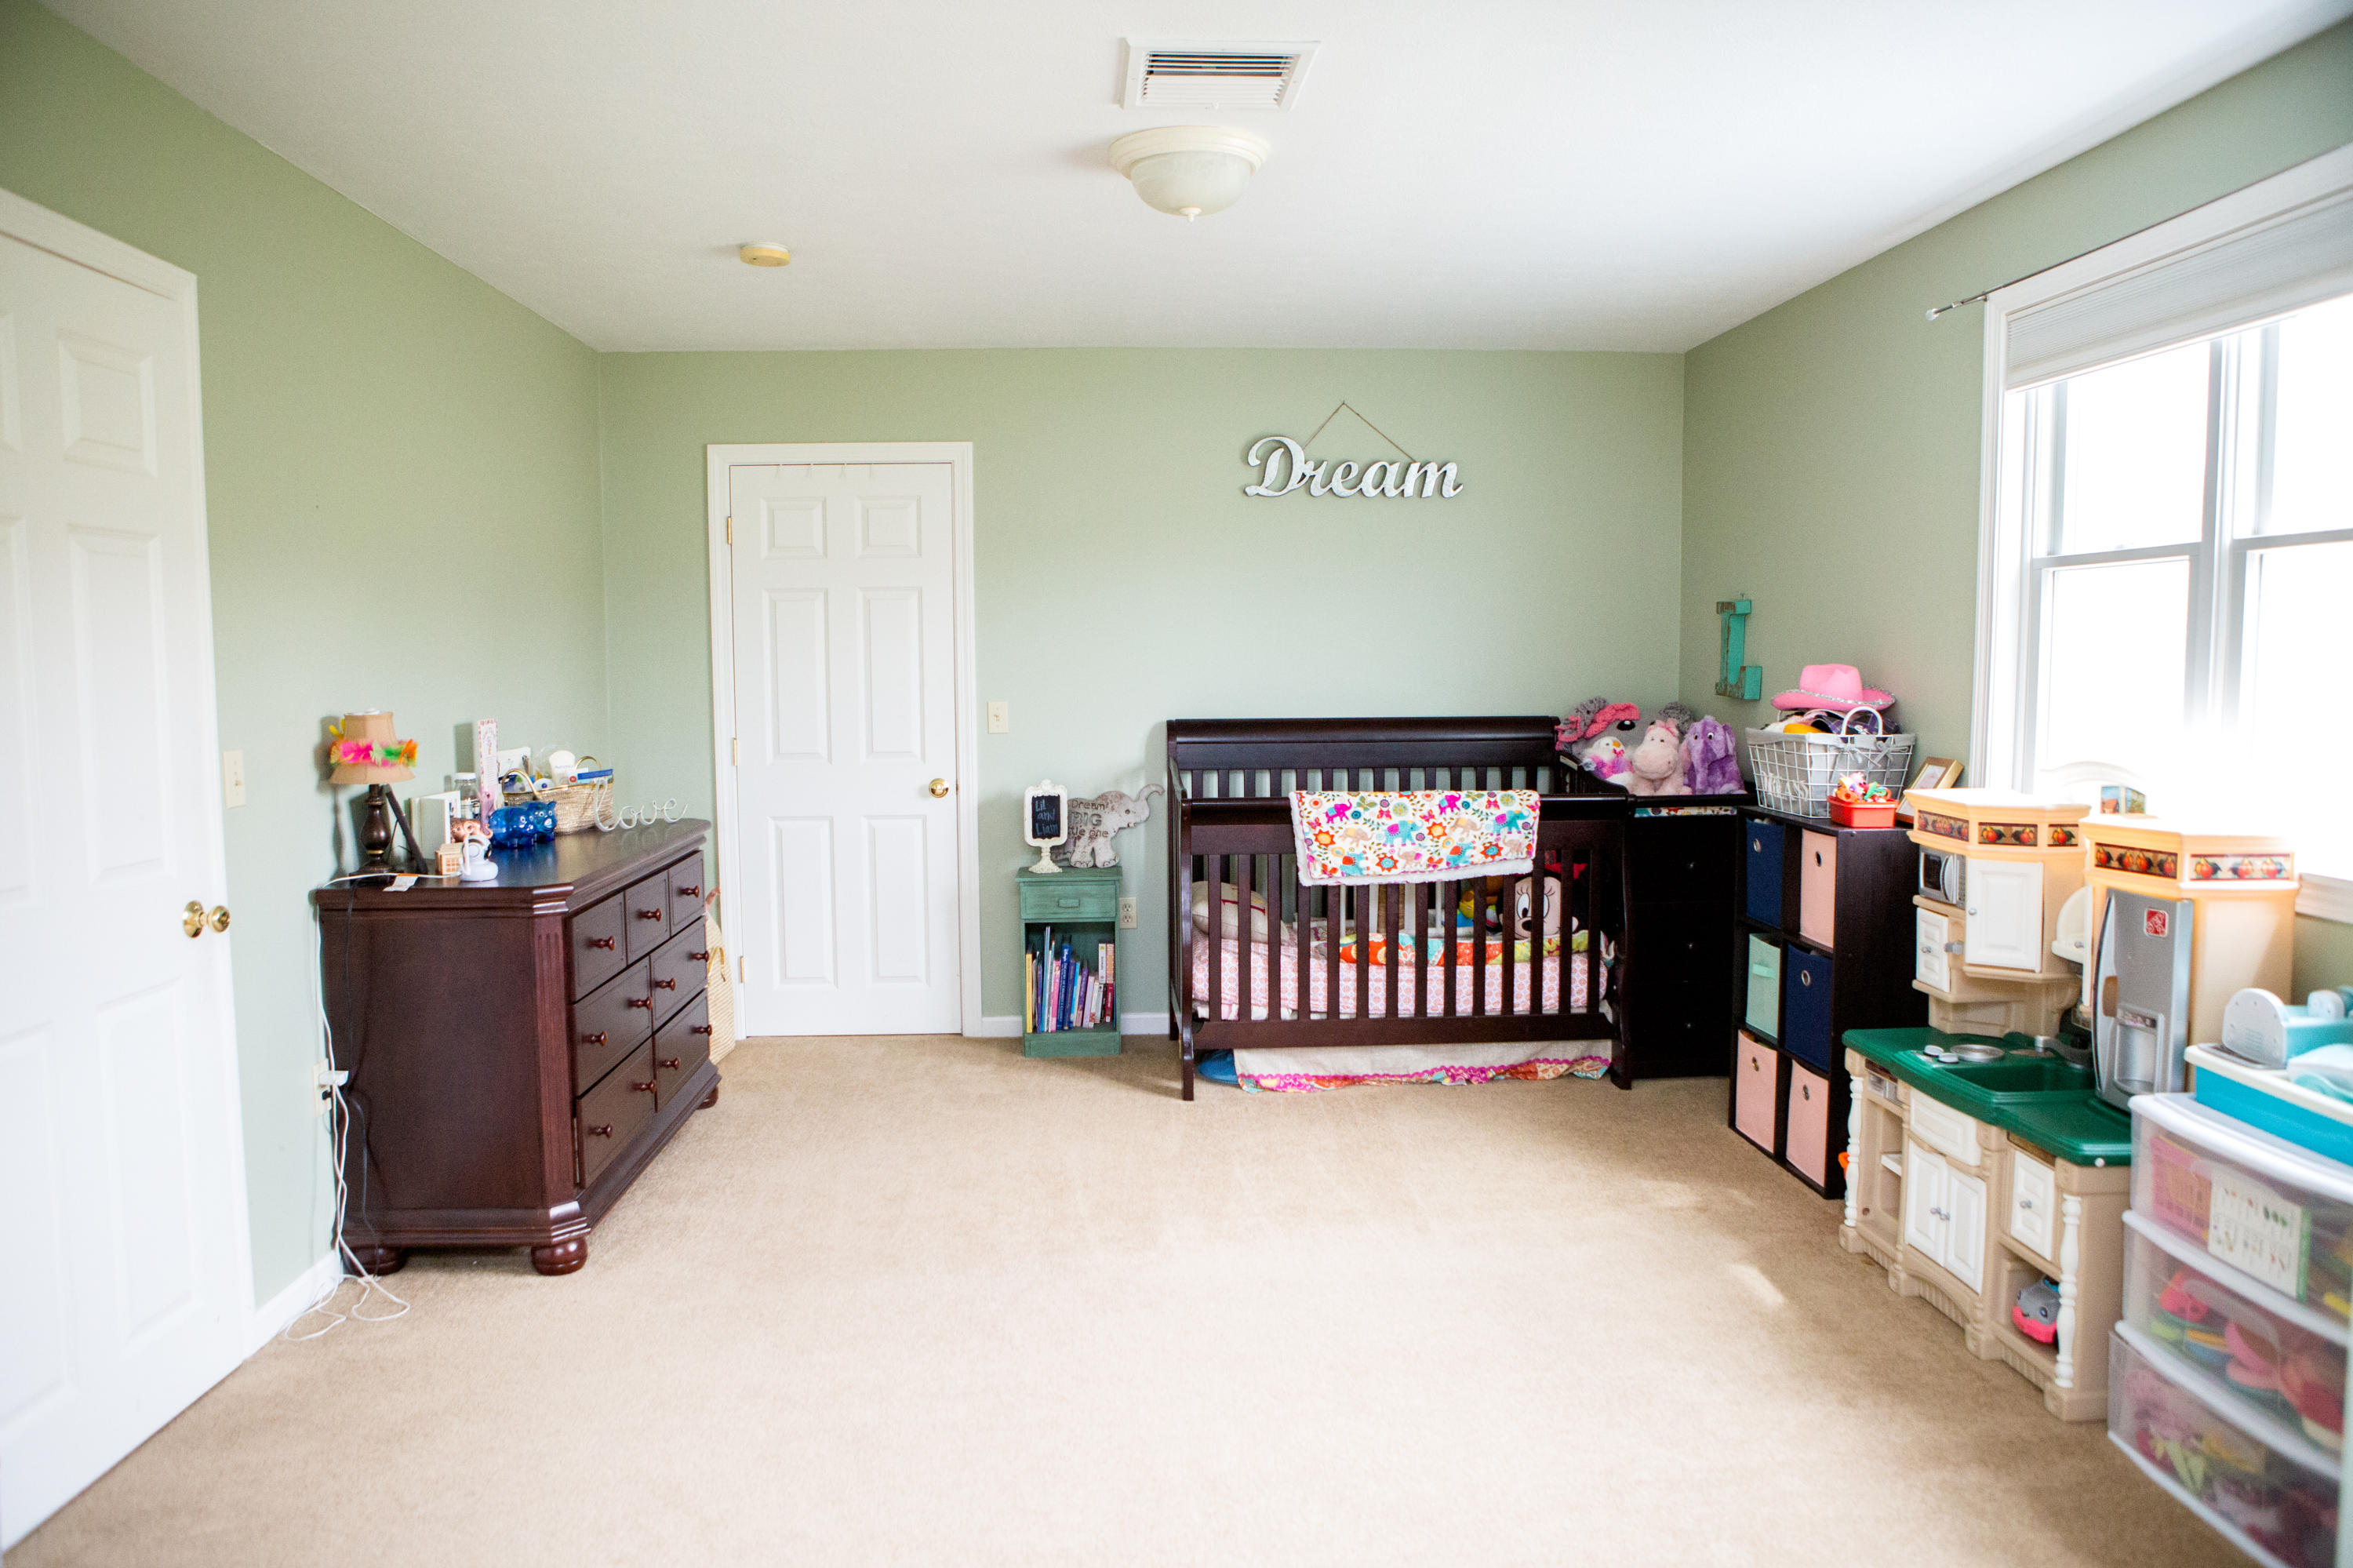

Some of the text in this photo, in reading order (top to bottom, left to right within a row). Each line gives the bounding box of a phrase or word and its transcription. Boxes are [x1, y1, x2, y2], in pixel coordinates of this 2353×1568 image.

[1244, 435, 1464, 498] Dream
[1715, 599, 1762, 701] L
[595, 776, 689, 832] love
[1071, 799, 1105, 810] Dream
[1071, 811, 1102, 827] BIG
[1089, 828, 1108, 839] one
